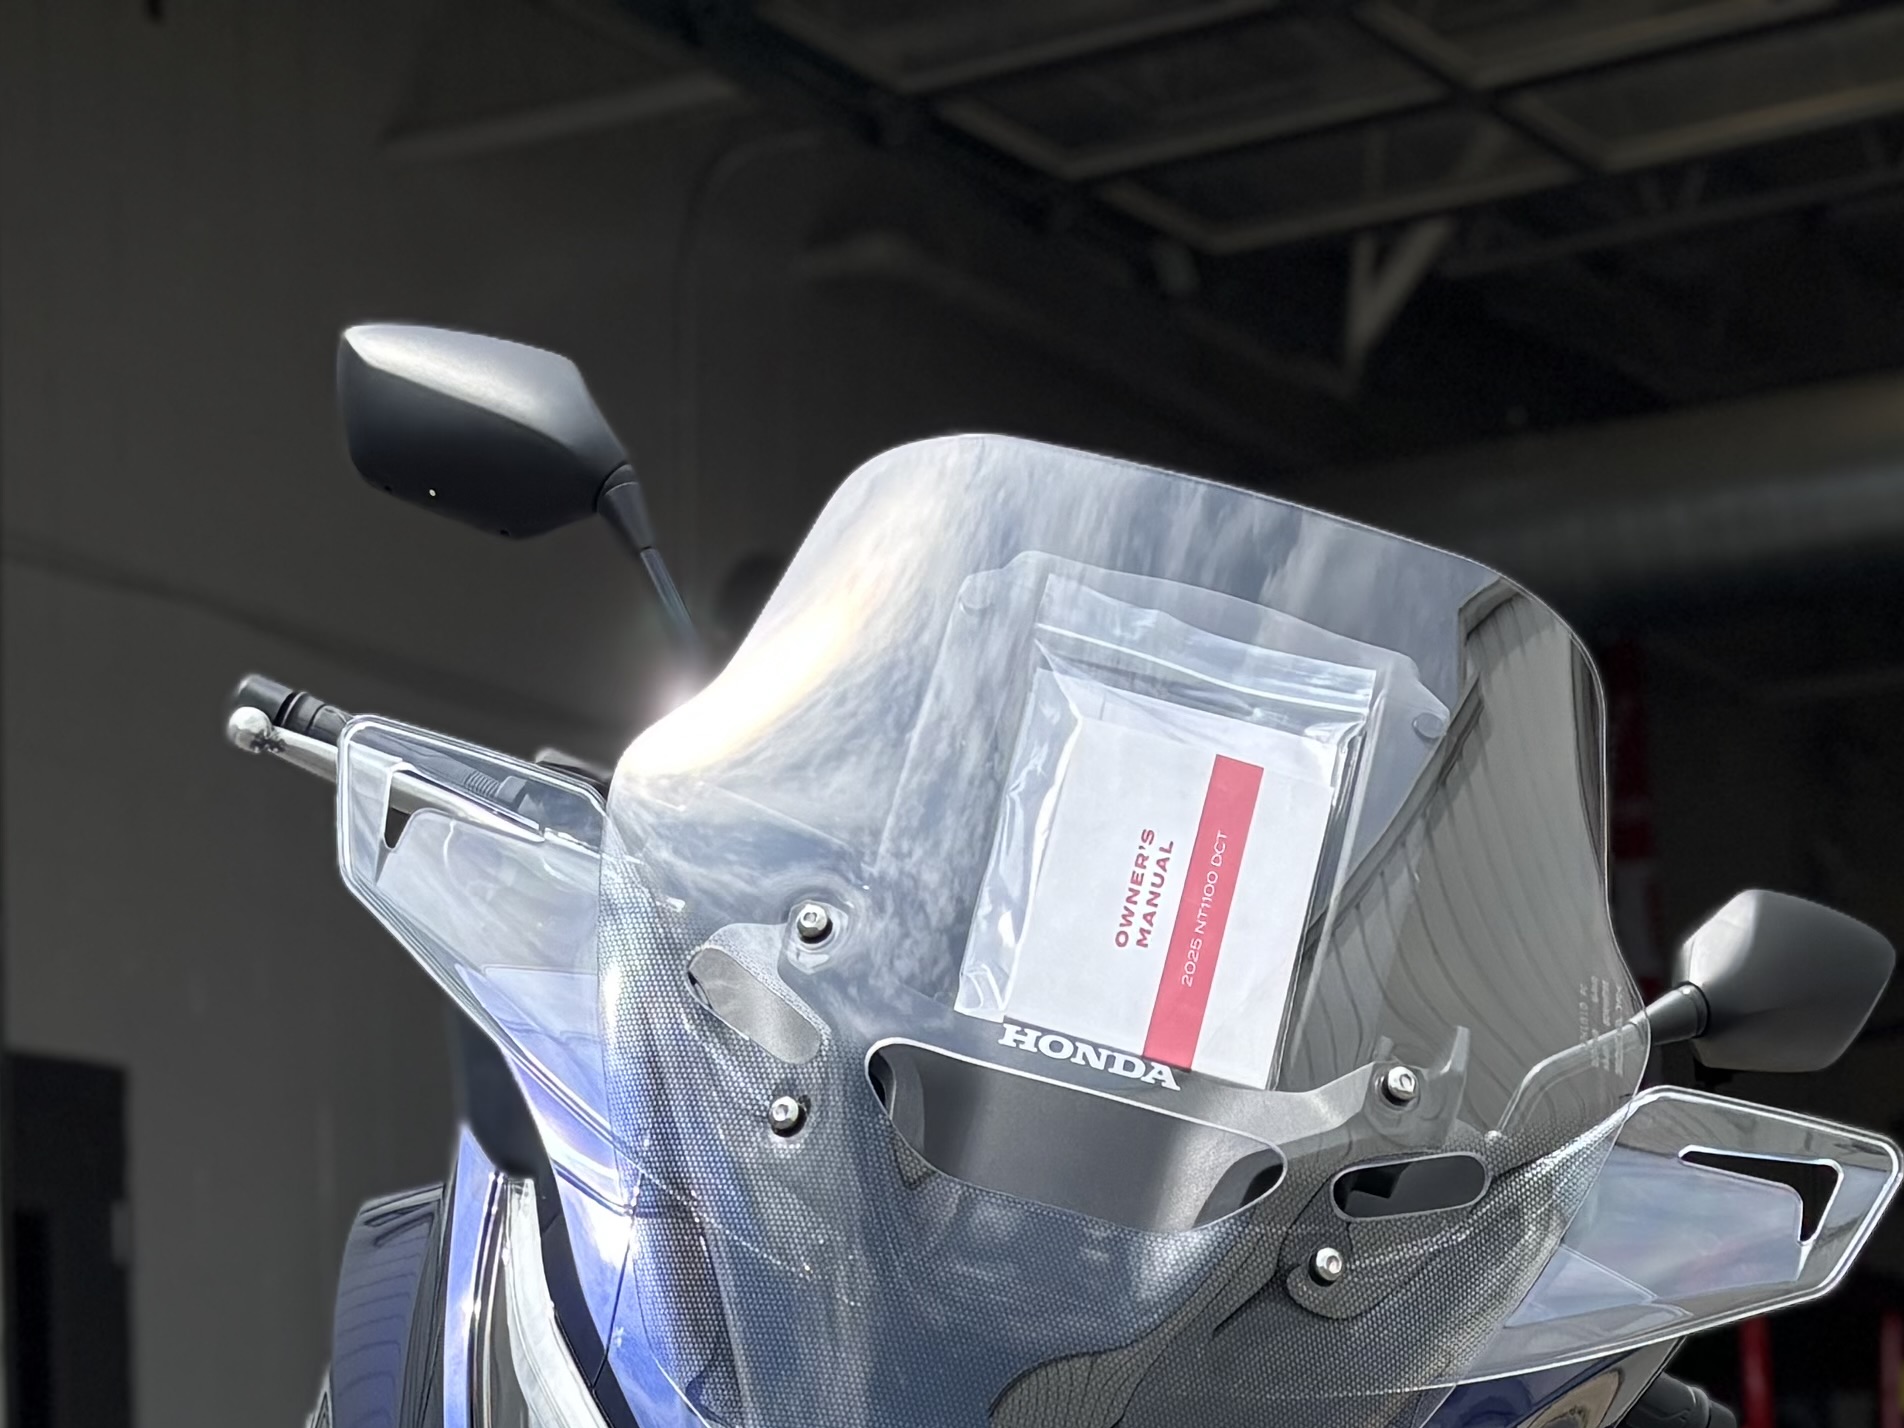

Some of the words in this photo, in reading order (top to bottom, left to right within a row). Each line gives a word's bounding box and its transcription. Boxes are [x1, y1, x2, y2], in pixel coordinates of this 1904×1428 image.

[1115, 829, 1155, 948] OWNER'S
[1135, 841, 1174, 948] MANUAL
[1182, 938, 1203, 987] 2025
[1194, 871, 1218, 934] NT1100
[1211, 830, 1228, 867] DCT
[998, 1023, 1181, 1091] HONDA
